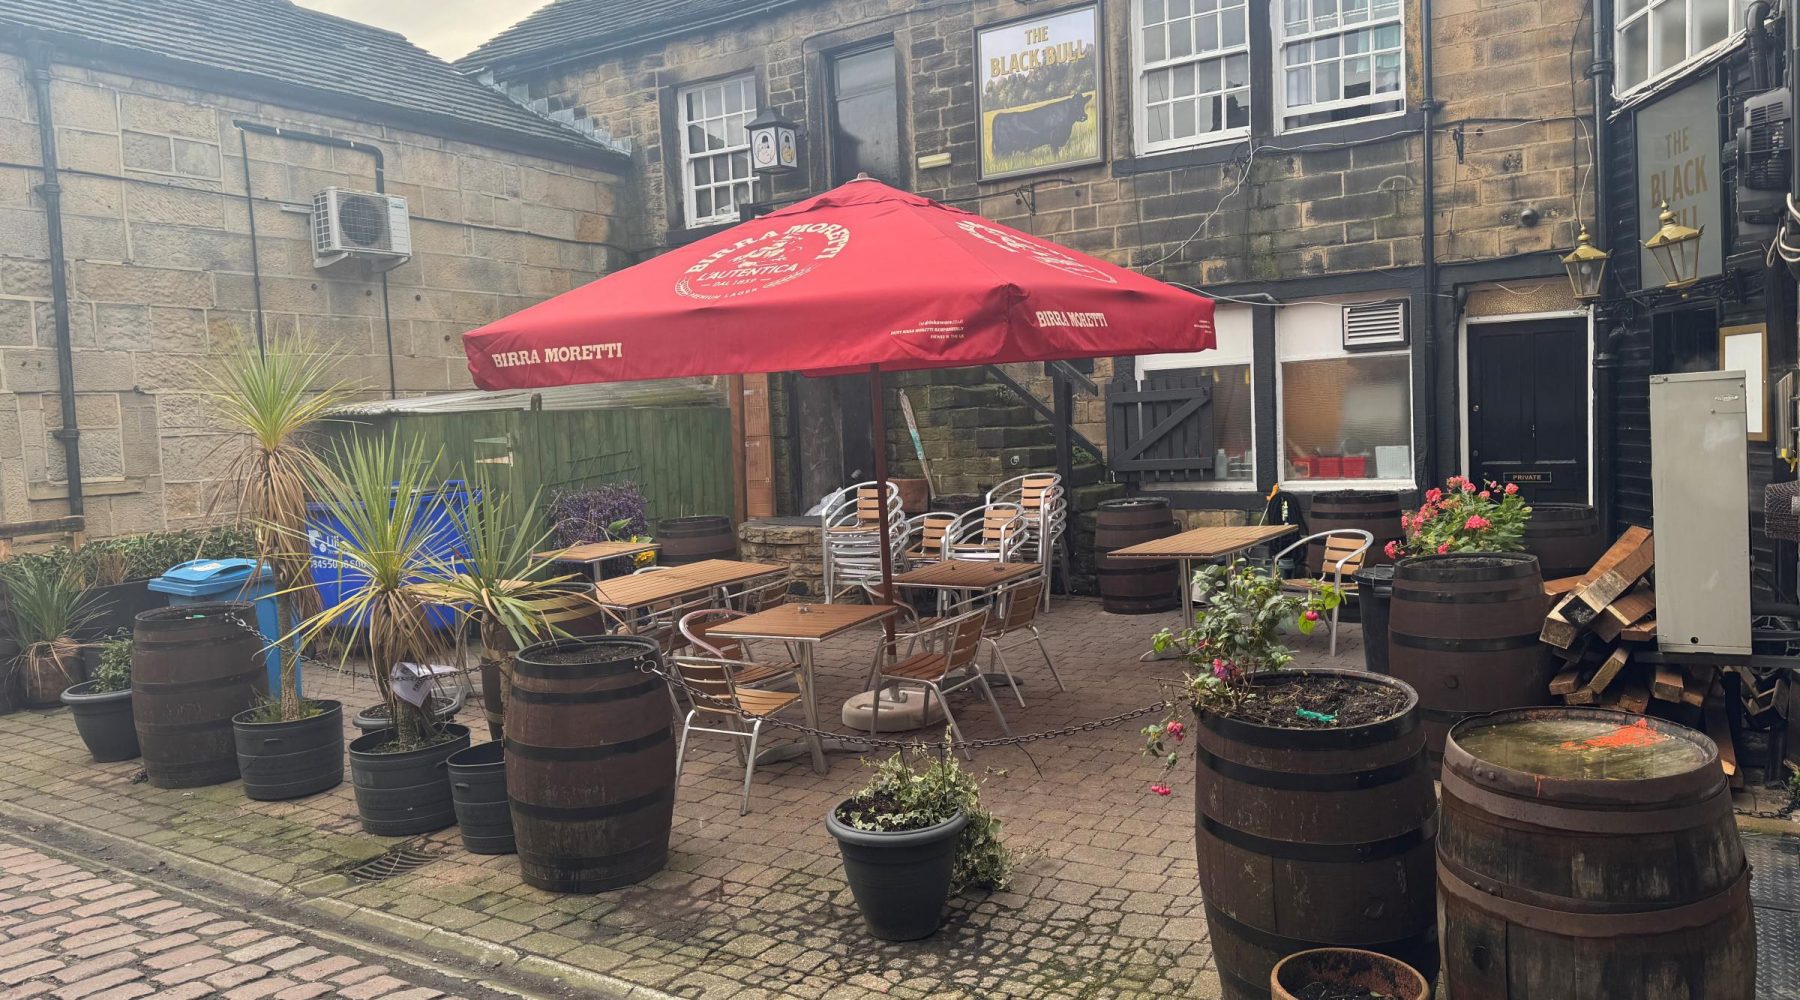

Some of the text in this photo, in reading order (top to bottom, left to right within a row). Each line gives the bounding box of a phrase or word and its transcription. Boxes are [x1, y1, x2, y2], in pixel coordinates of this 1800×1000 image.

[1024, 26, 1049, 45] THE
[990, 40, 1086, 77] BLACK BULL
[1665, 127, 1689, 159] THE
[1651, 154, 1708, 208] BLACK
[685, 222, 850, 274] BIRRA MORETTI
[1036, 311, 1108, 328] BIRRA MORETTI
[492, 343, 622, 367] BIRRA MORETTI
